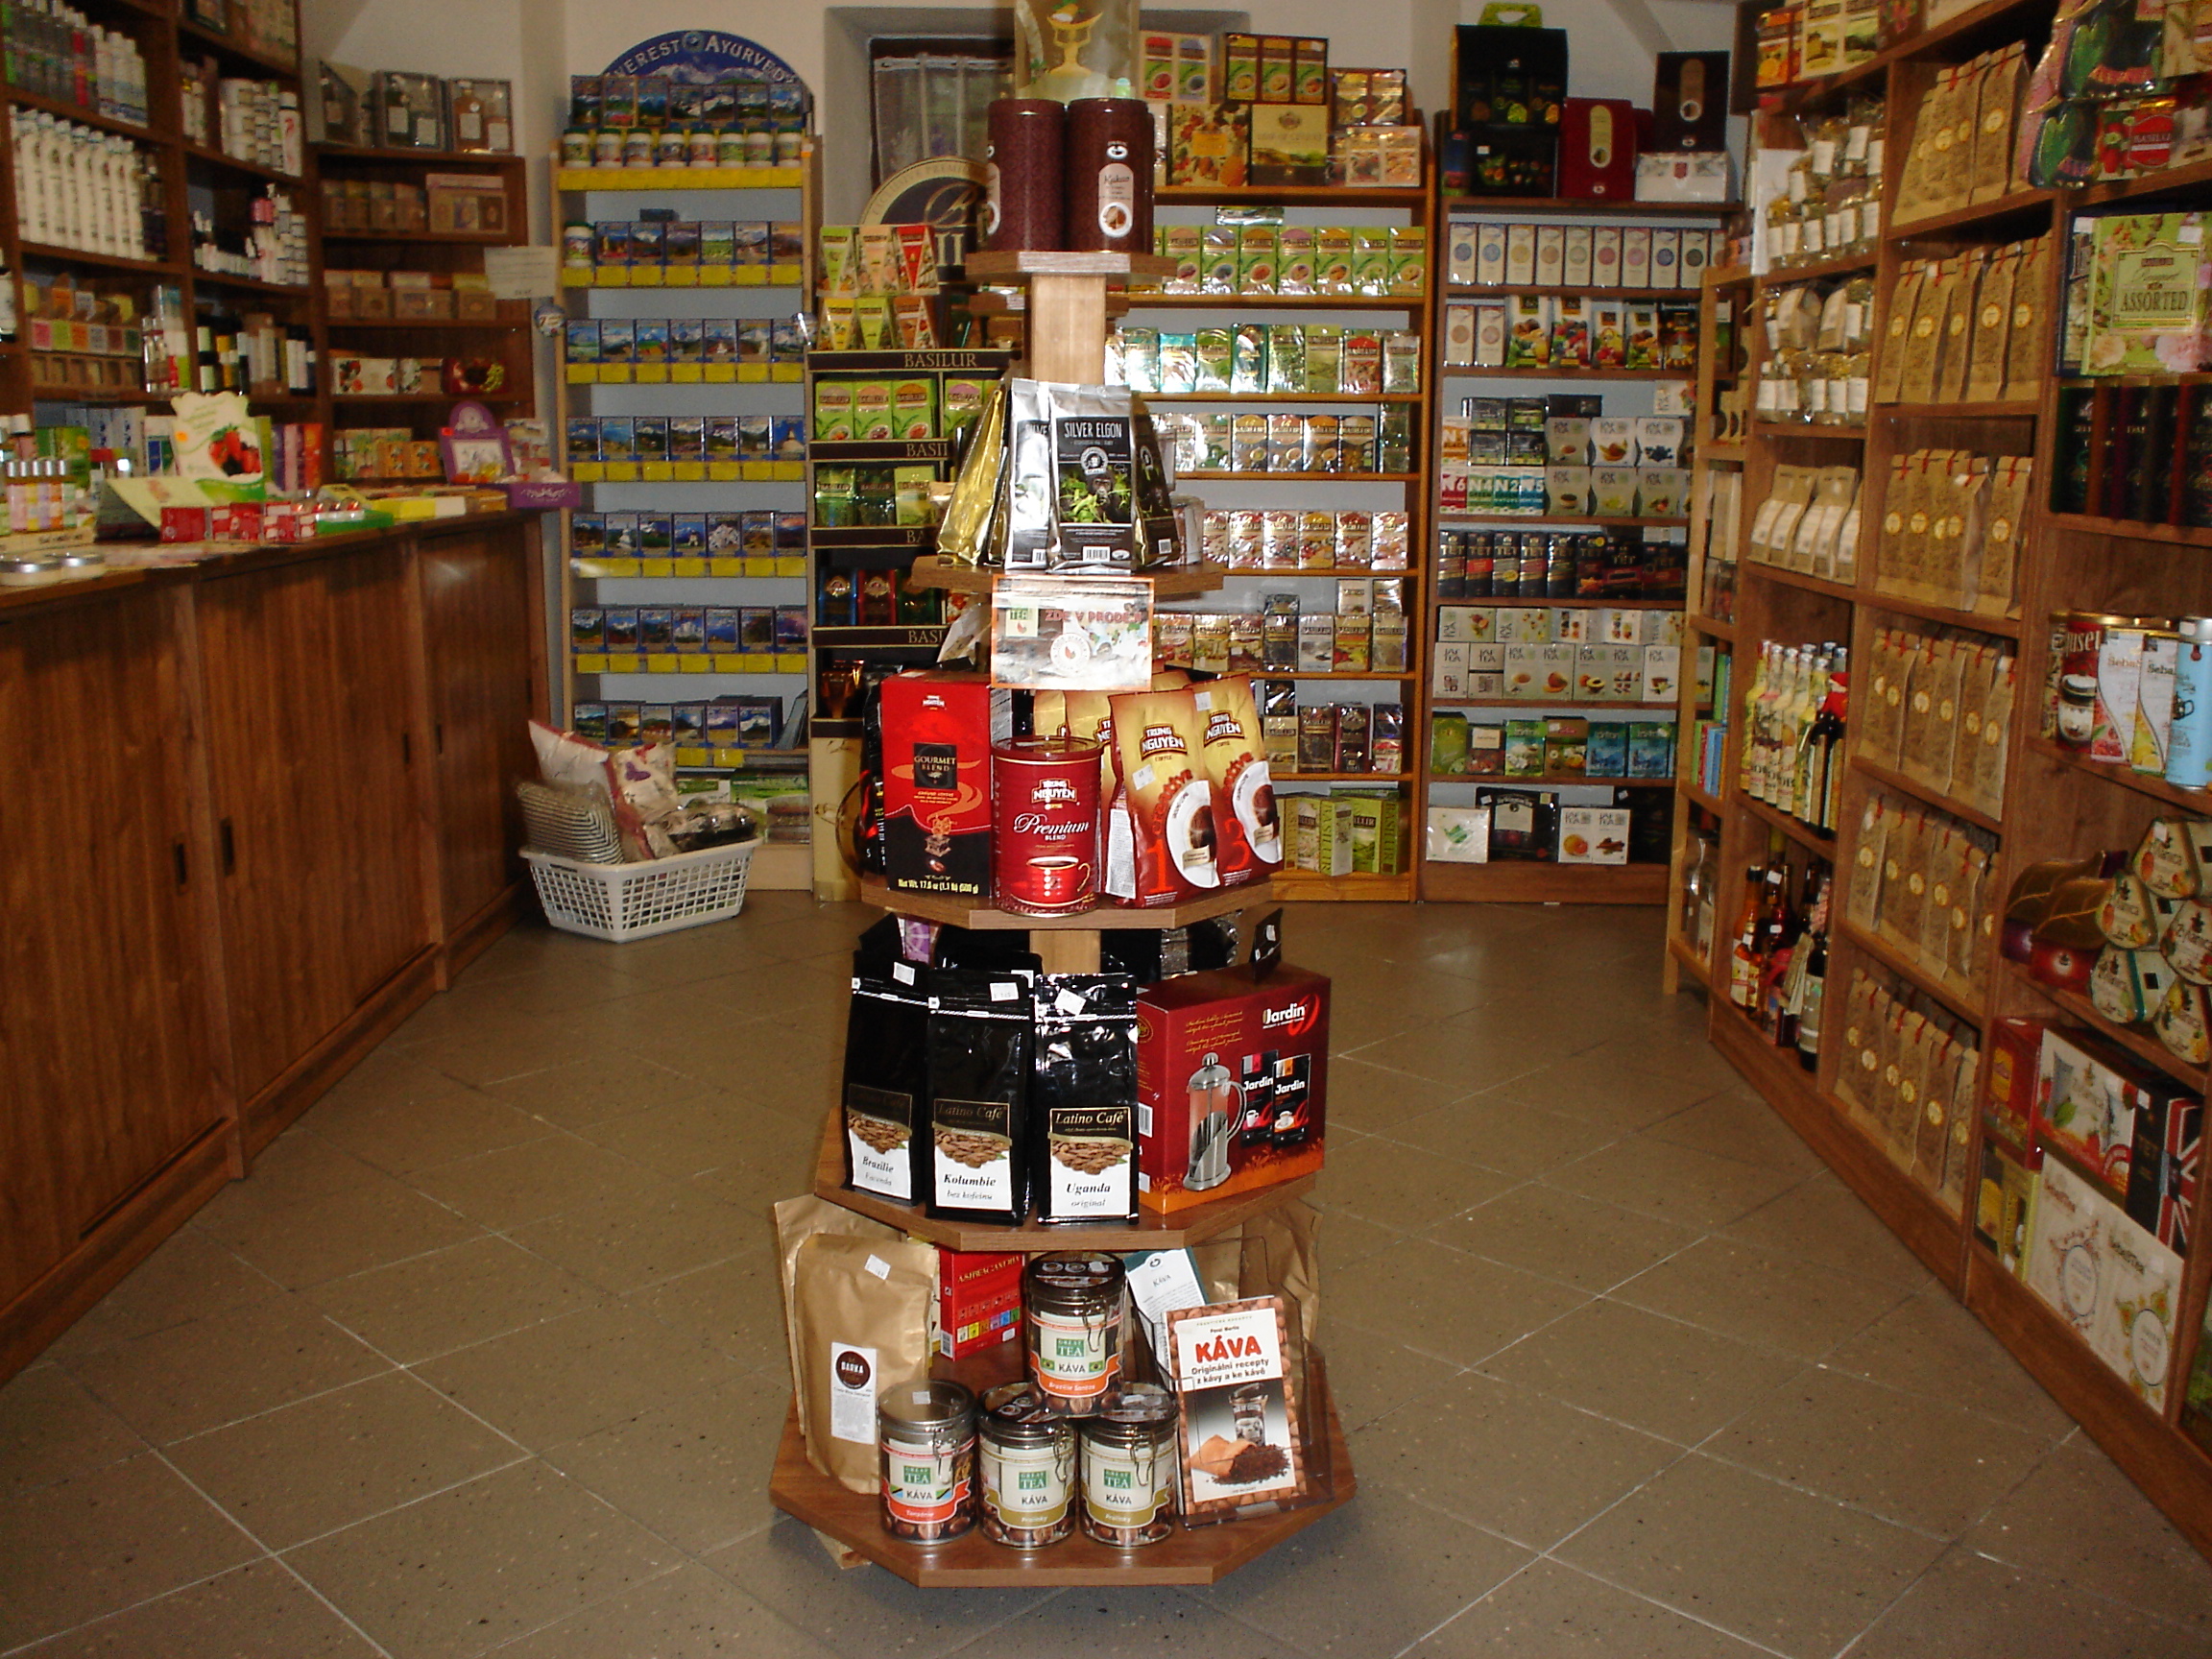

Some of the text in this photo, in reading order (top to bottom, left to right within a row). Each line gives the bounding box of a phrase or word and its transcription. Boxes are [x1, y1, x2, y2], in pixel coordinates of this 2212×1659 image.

[606, 39, 681, 76] VEREST
[2120, 291, 2188, 313] ASSORTED
[904, 352, 977, 368] BASILUR
[1064, 422, 1122, 438] SILVER ELGON
[1046, 610, 1071, 622] ZDE
[1146, 725, 1172, 736] TRUNG
[1142, 735, 1184, 752] NGUYEN
[914, 756, 956, 765] GOURMET
[1034, 787, 1076, 800] NGUYEN
[1014, 813, 1090, 836] Premium
[1224, 818, 1251, 871] 3
[1147, 839, 1173, 893] 1
[1262, 1003, 1306, 1025] Jardin
[1244, 1076, 1273, 1092] Jardin
[1275, 1080, 1306, 1094] Jardin
[1055, 1112, 1093, 1125] Latino
[944, 1173, 997, 1188] Kolumbie
[1066, 1182, 1112, 1196] Uganda
[1070, 1198, 1106, 1209] original
[1059, 1346, 1083, 1357] TEA
[1195, 1334, 1262, 1363] KÁVA
[1058, 1361, 1086, 1373] KÁVA
[1235, 1358, 1269, 1369] recepty
[905, 1473, 930, 1484] TEA
[1021, 1479, 1046, 1489] TEA
[1106, 1477, 1131, 1487] TEA
[906, 1488, 933, 1501] KÁVA
[1022, 1493, 1047, 1505] KÁVA
[1106, 1493, 1132, 1505] KÁVA
